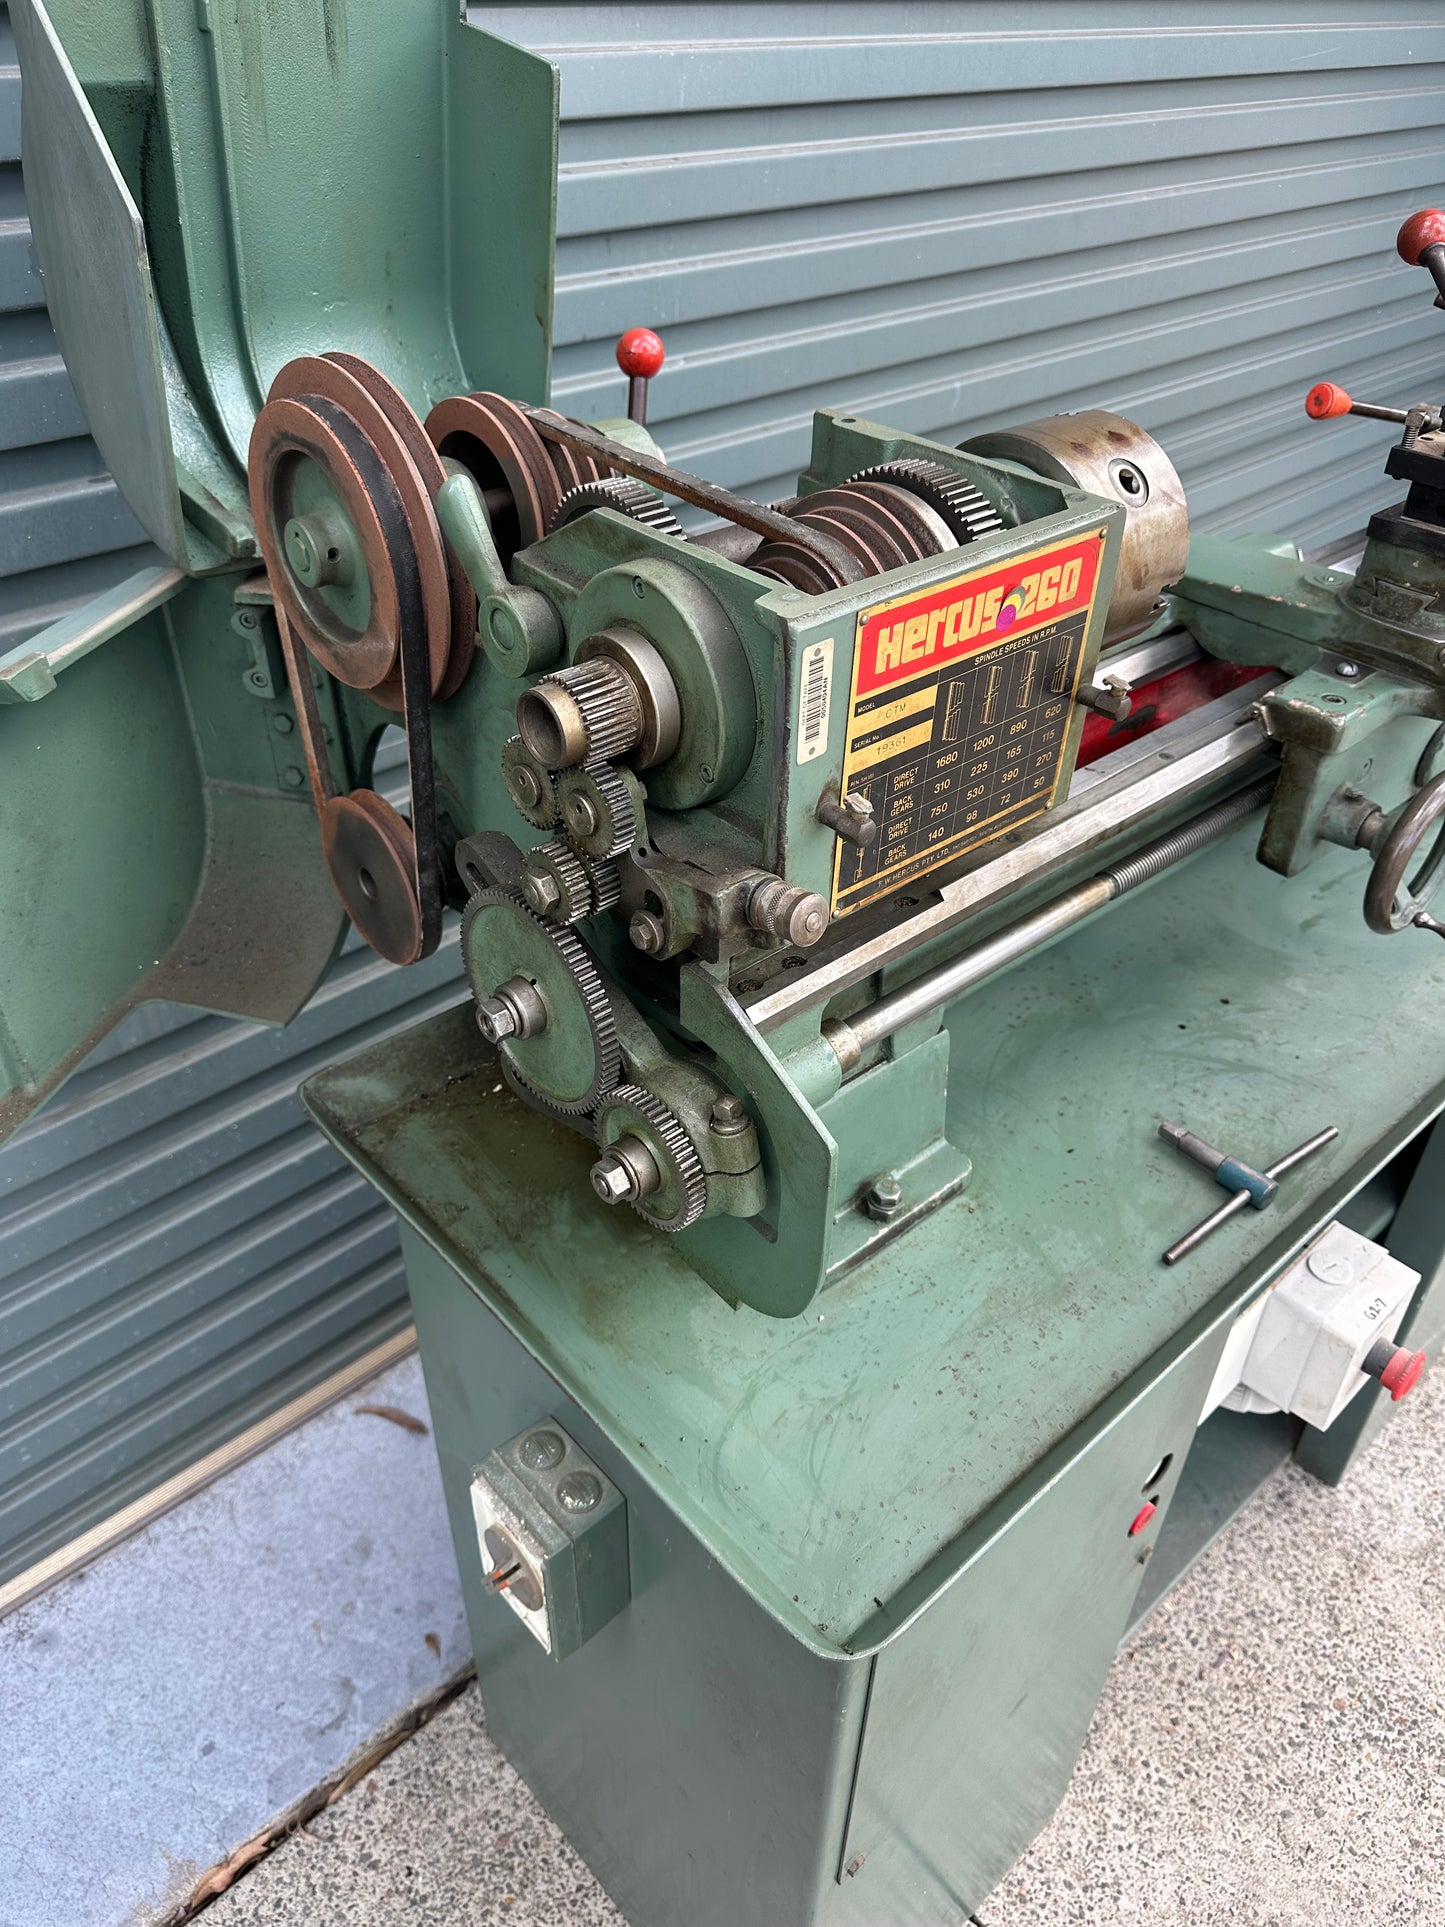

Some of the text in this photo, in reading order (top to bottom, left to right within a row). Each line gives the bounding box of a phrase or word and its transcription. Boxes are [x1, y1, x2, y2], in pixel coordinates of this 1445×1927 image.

[1015, 557, 1083, 620] 260
[974, 647, 1004, 666] SPINDLE
[1004, 636, 1031, 653] SPEEDS
[1031, 633, 1040, 642] IN
[858, 702, 876, 713] MODEL
[1045, 703, 1062, 719] 620
[1009, 719, 1028, 735] 890
[973, 734, 995, 752] 1200
[1042, 729, 1055, 742] 115
[854, 738, 871, 750] SERIAL
[936, 751, 958, 769] 1680
[1006, 745, 1022, 760] 165
[1035, 751, 1052, 767] 270
[893, 767, 919, 784] DIRECT
[970, 761, 988, 777] 225
[1001, 768, 1019, 783] 390
[894, 777, 914, 791] DRIVE
[933, 778, 951, 794] 310
[1033, 776, 1045, 789] 50
[966, 784, 984, 800] 530
[1000, 793, 1011, 806] 72
[890, 800, 914, 817] GEARS
[893, 794, 913, 809] BACK
[930, 802, 948, 818] 750
[965, 810, 978, 823] 98
[888, 817, 912, 834] DIRECT
[888, 826, 909, 841] DRIVE
[927, 826, 944, 841] 140
[884, 850, 907, 865] GEARS
[888, 844, 906, 857] BACK
[892, 862, 920, 881] HERCUS
